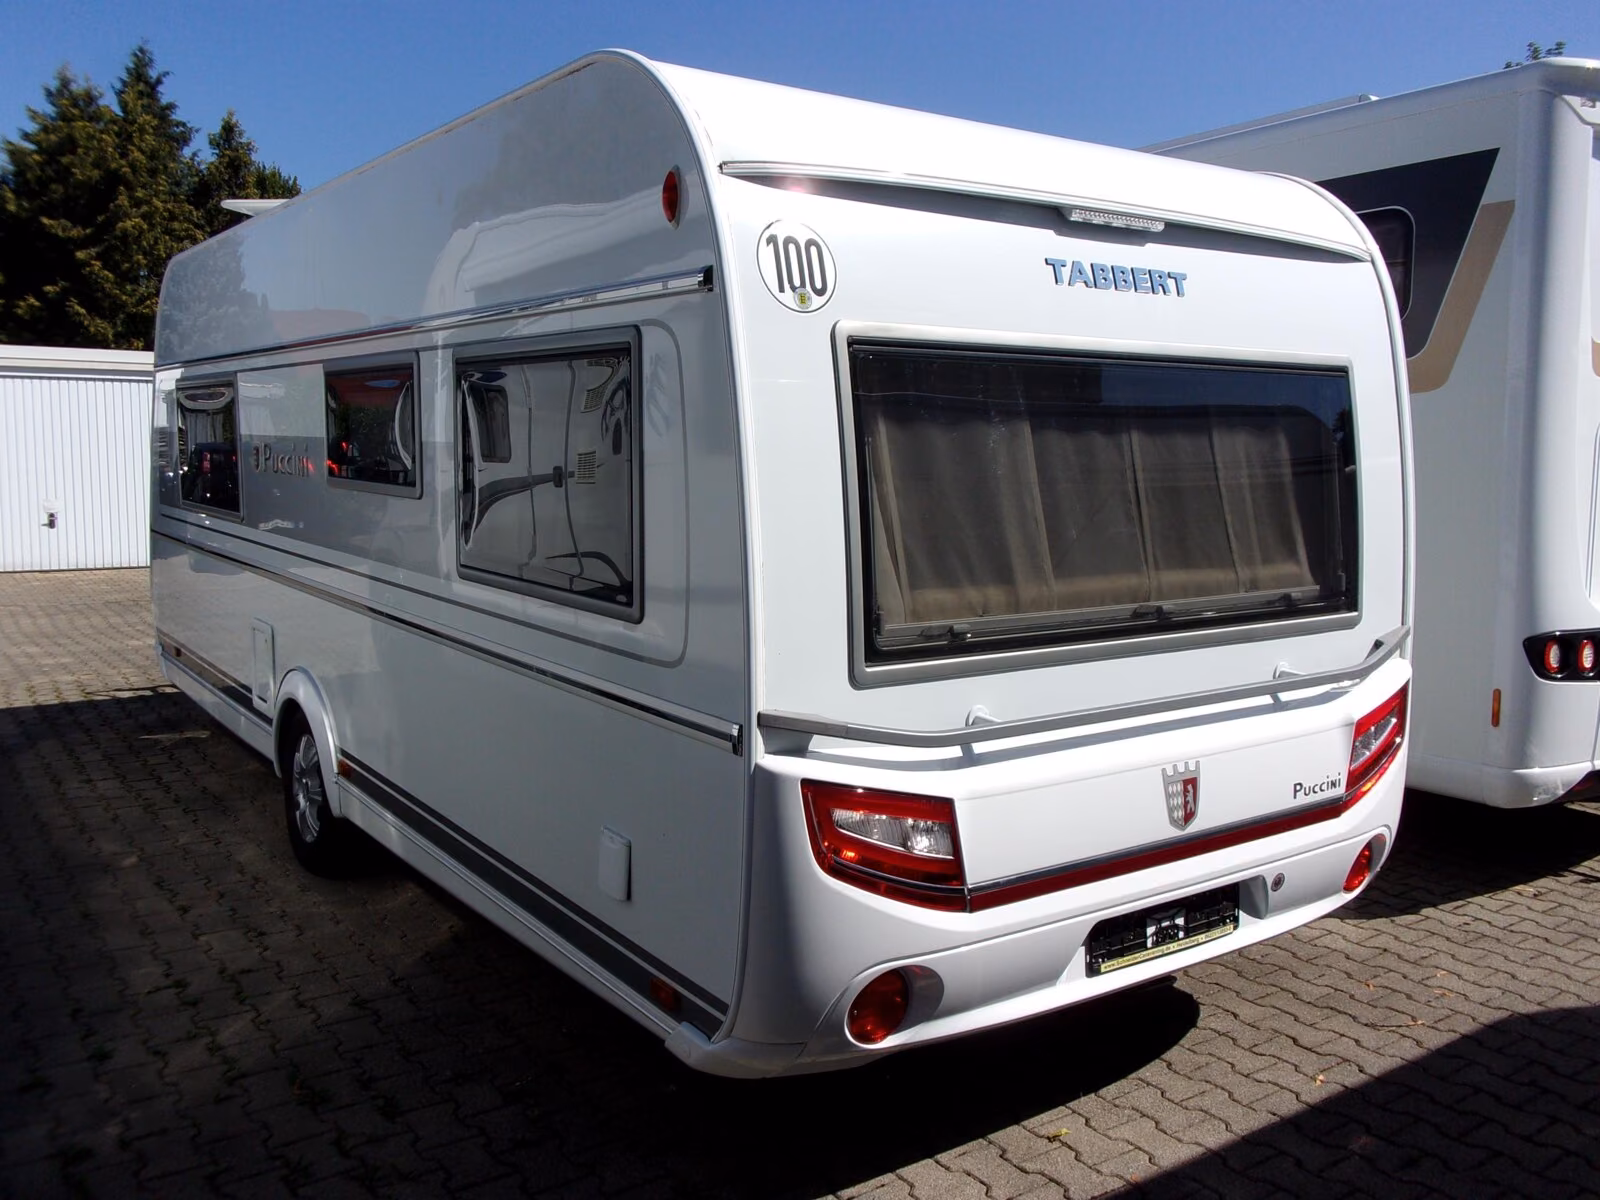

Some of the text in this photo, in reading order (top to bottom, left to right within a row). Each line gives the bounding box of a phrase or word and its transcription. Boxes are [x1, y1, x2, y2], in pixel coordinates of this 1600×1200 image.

[765, 233, 828, 297] 100
[1045, 257, 1187, 298] TABBERT
[1293, 771, 1341, 800] Puccini
